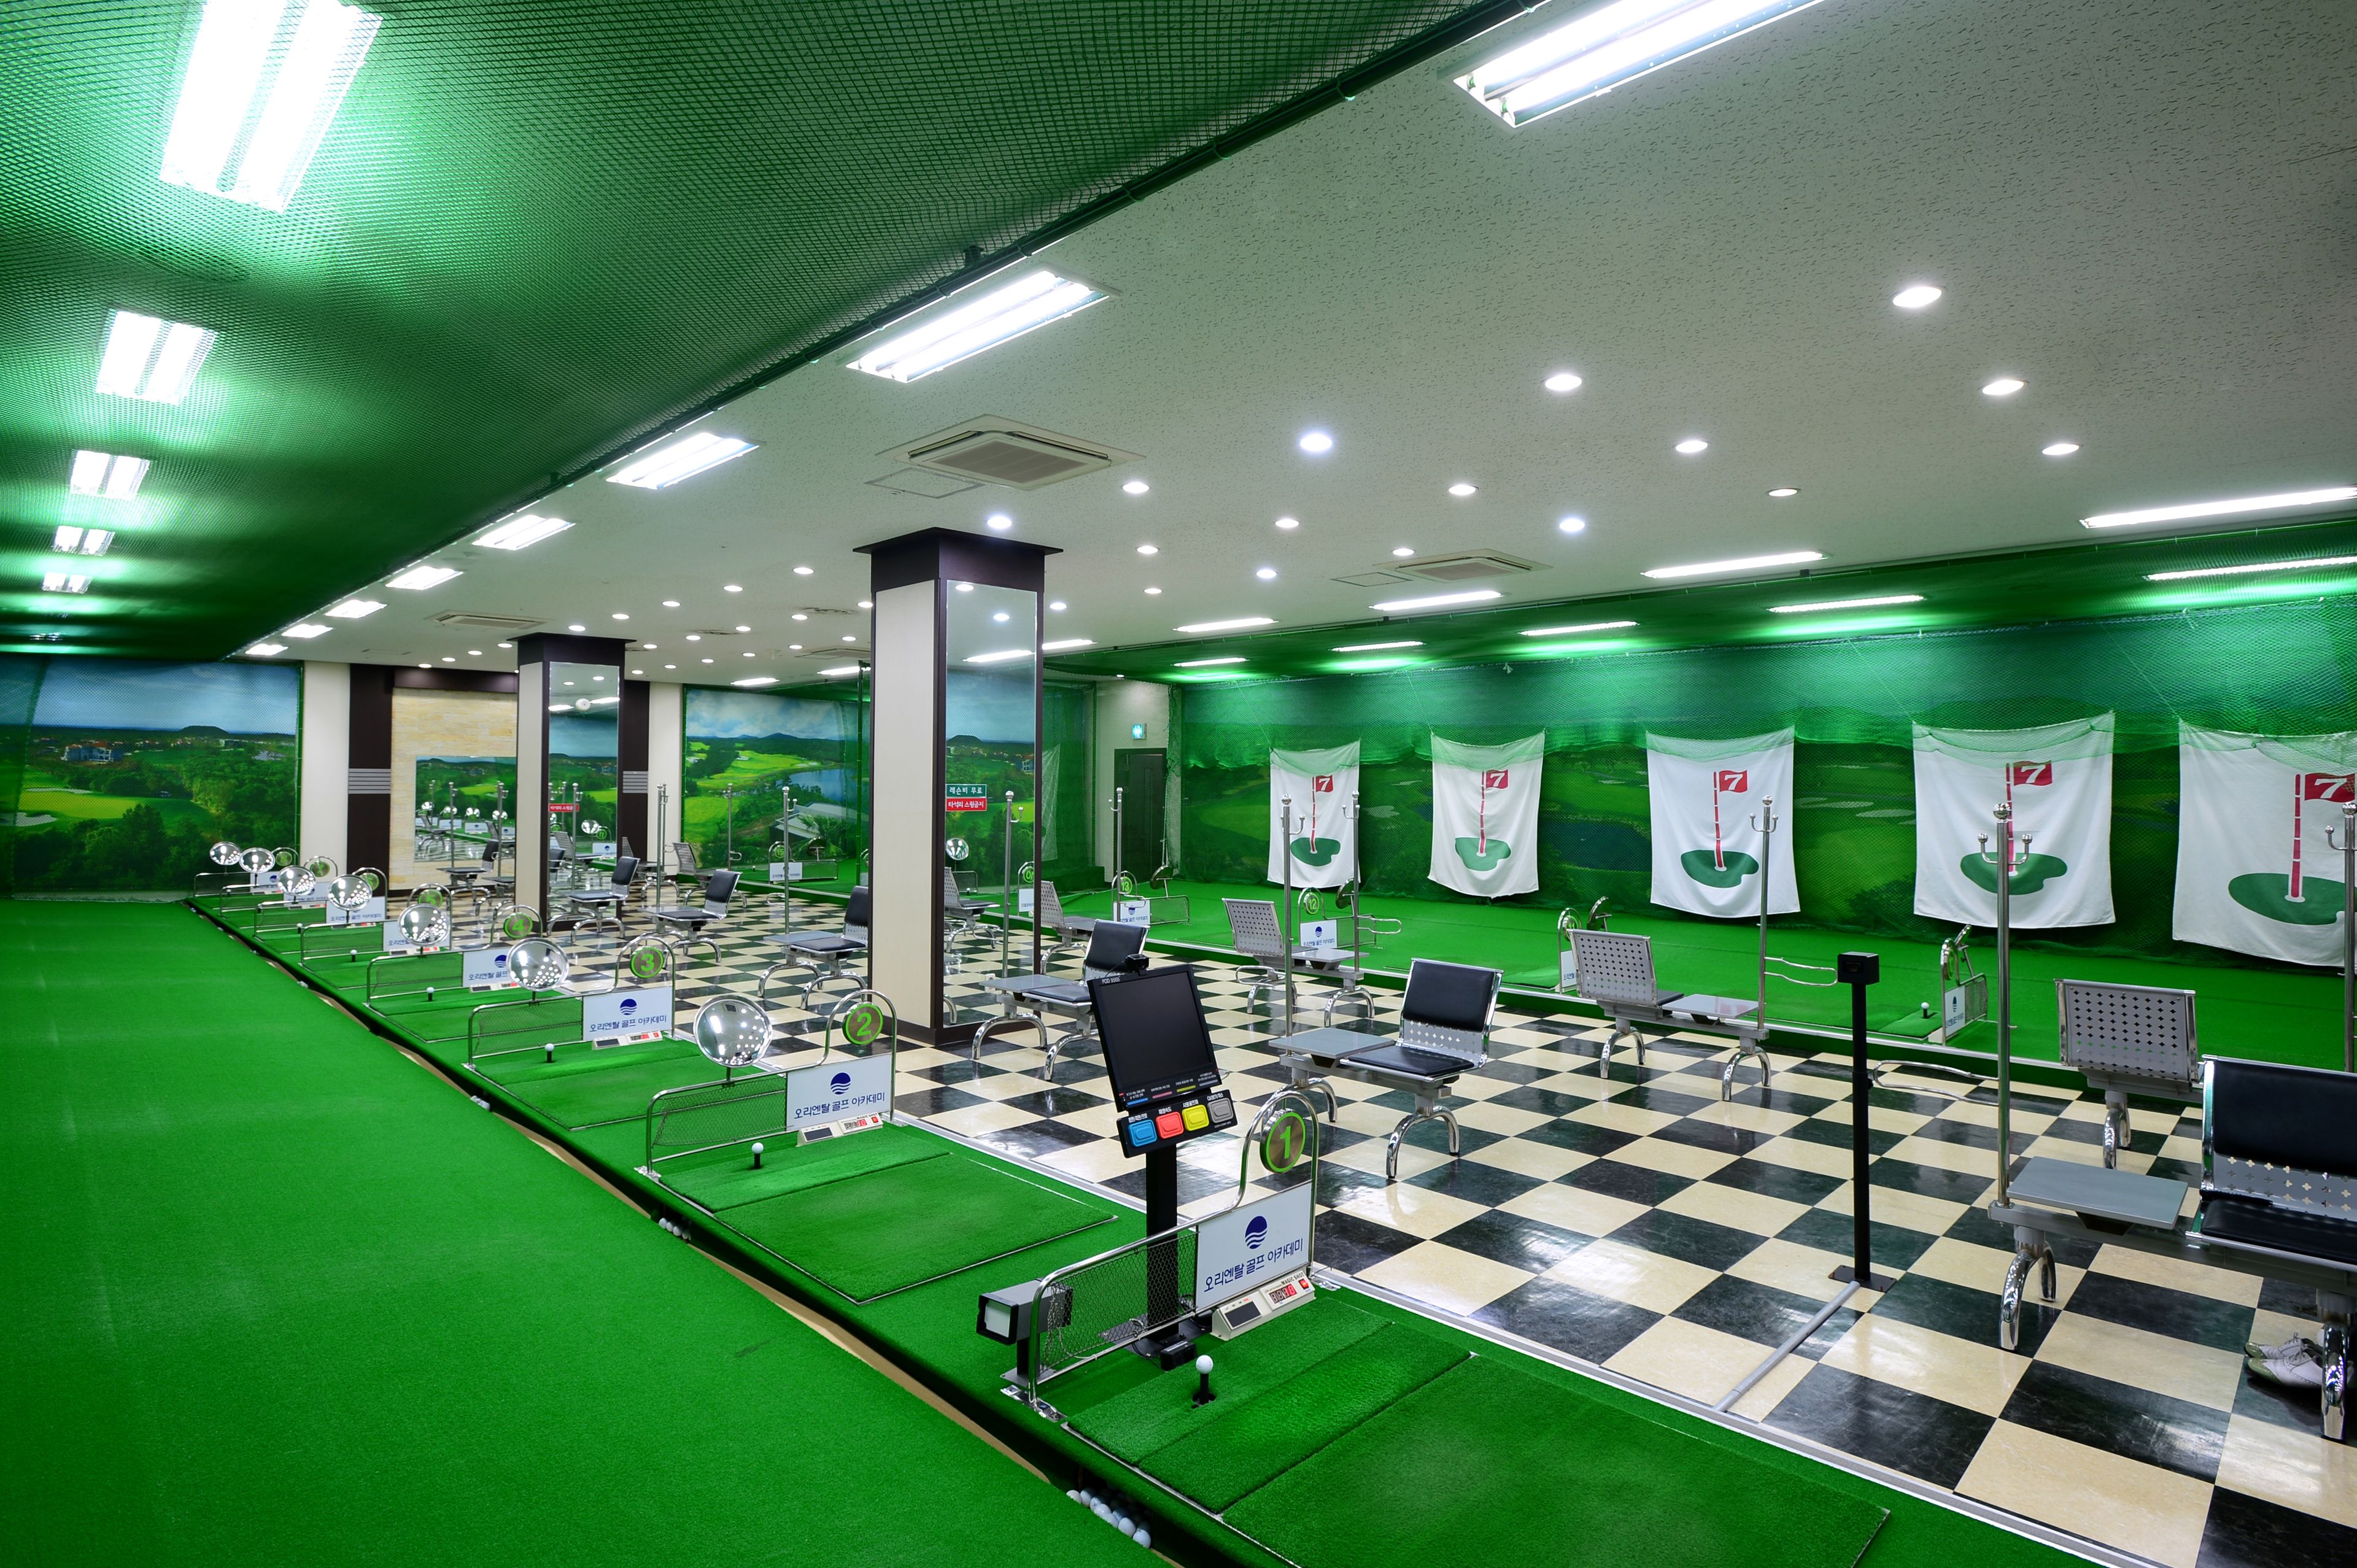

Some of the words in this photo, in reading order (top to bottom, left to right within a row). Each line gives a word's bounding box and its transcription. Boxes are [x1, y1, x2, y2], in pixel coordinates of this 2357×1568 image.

[1490, 773, 1505, 787] 7
[1724, 774, 1743, 790] 7
[2021, 765, 2046, 783] 7
[949, 787, 968, 795] 레슨비
[1318, 778, 1330, 791] 7
[2314, 778, 2348, 798] 7
[1121, 881, 1129, 892] 13
[1309, 898, 1317, 910] 12
[512, 919, 525, 932] 4
[641, 954, 655, 972] 3
[468, 972, 495, 981] 오리엔탈
[589, 1021, 620, 1033] 오리엔탈
[621, 1019, 636, 1029] 골프
[638, 1015, 667, 1025] 아카데미
[856, 1013, 872, 1037] 2
[794, 1103, 830, 1119] 오리엔탈
[832, 1099, 850, 1112] 골프
[852, 1092, 885, 1106] 아카데미
[1280, 1126, 1291, 1159] 1
[1204, 1263, 1245, 1292] 오리엔탈
[1246, 1254, 1265, 1275] 골프
[1268, 1238, 1303, 1263] 아카데미
[1281, 1276, 1294, 1286] MAGIC
[1295, 1272, 1304, 1280] SHOT
